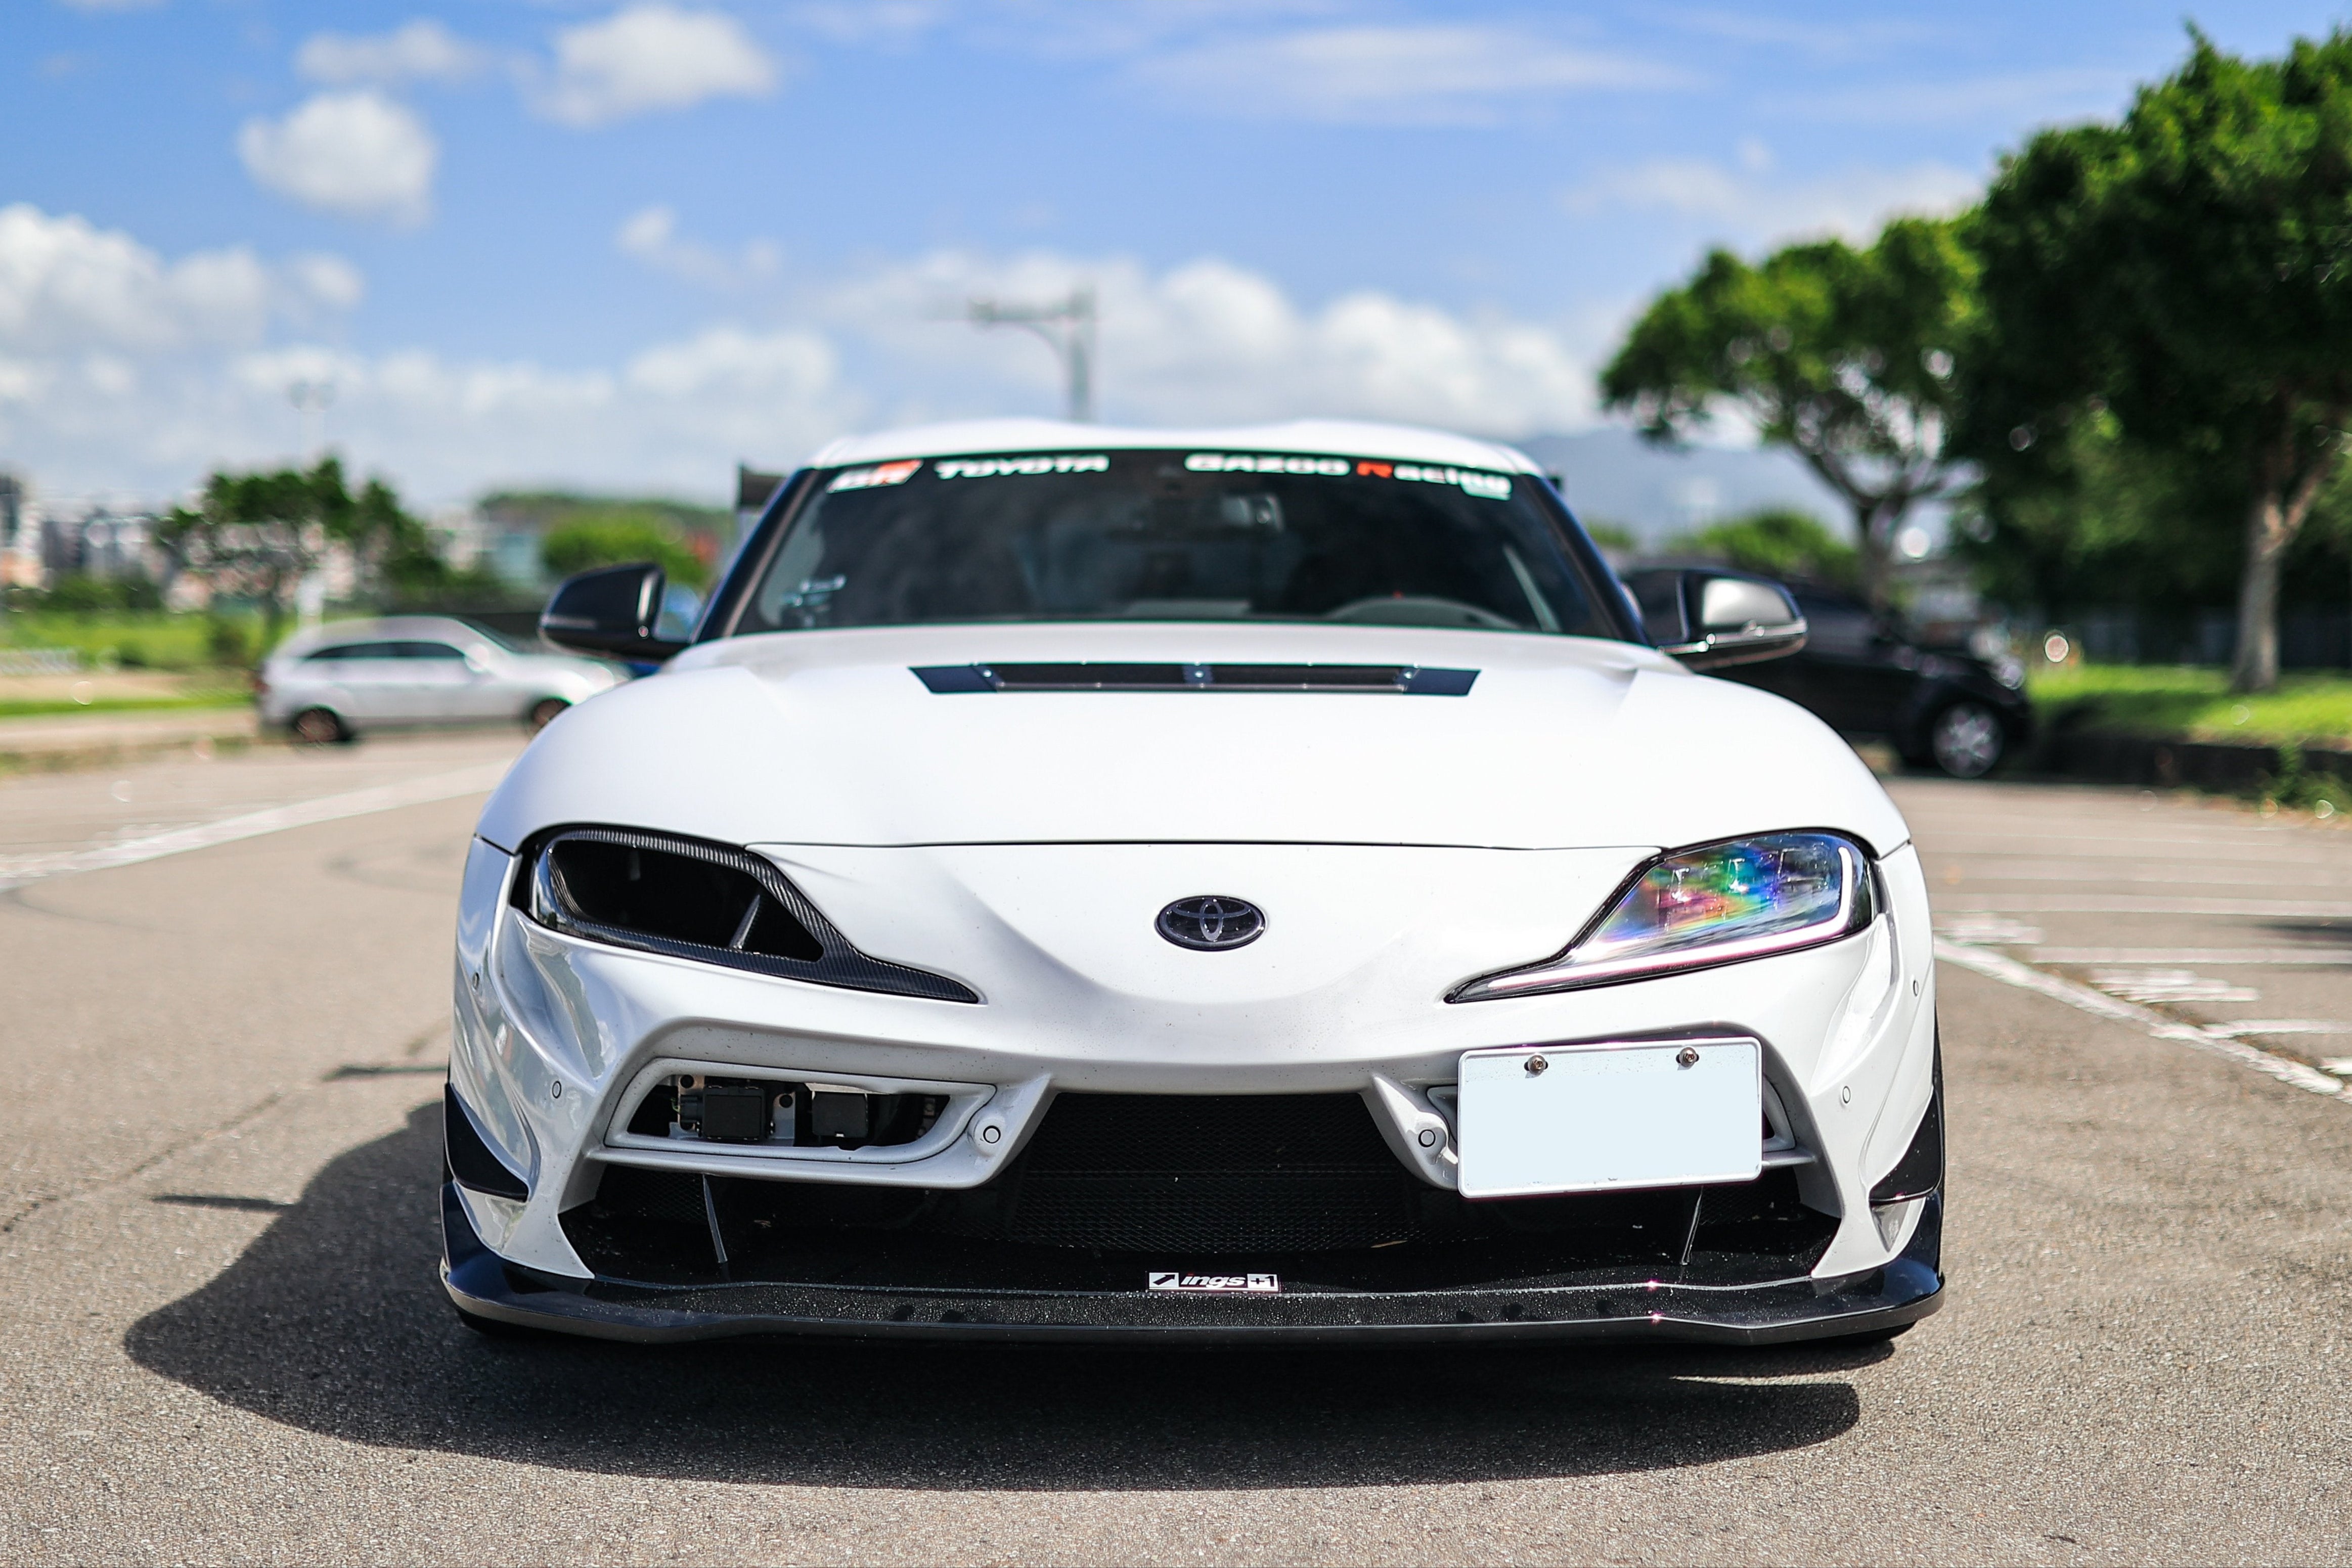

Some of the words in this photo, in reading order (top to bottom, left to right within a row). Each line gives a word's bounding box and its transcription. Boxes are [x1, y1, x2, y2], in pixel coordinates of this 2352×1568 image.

[934, 455, 1110, 479] TOYOTA
[1184, 453, 1351, 476] GAZOO
[1180, 1273, 1246, 1288] ings
